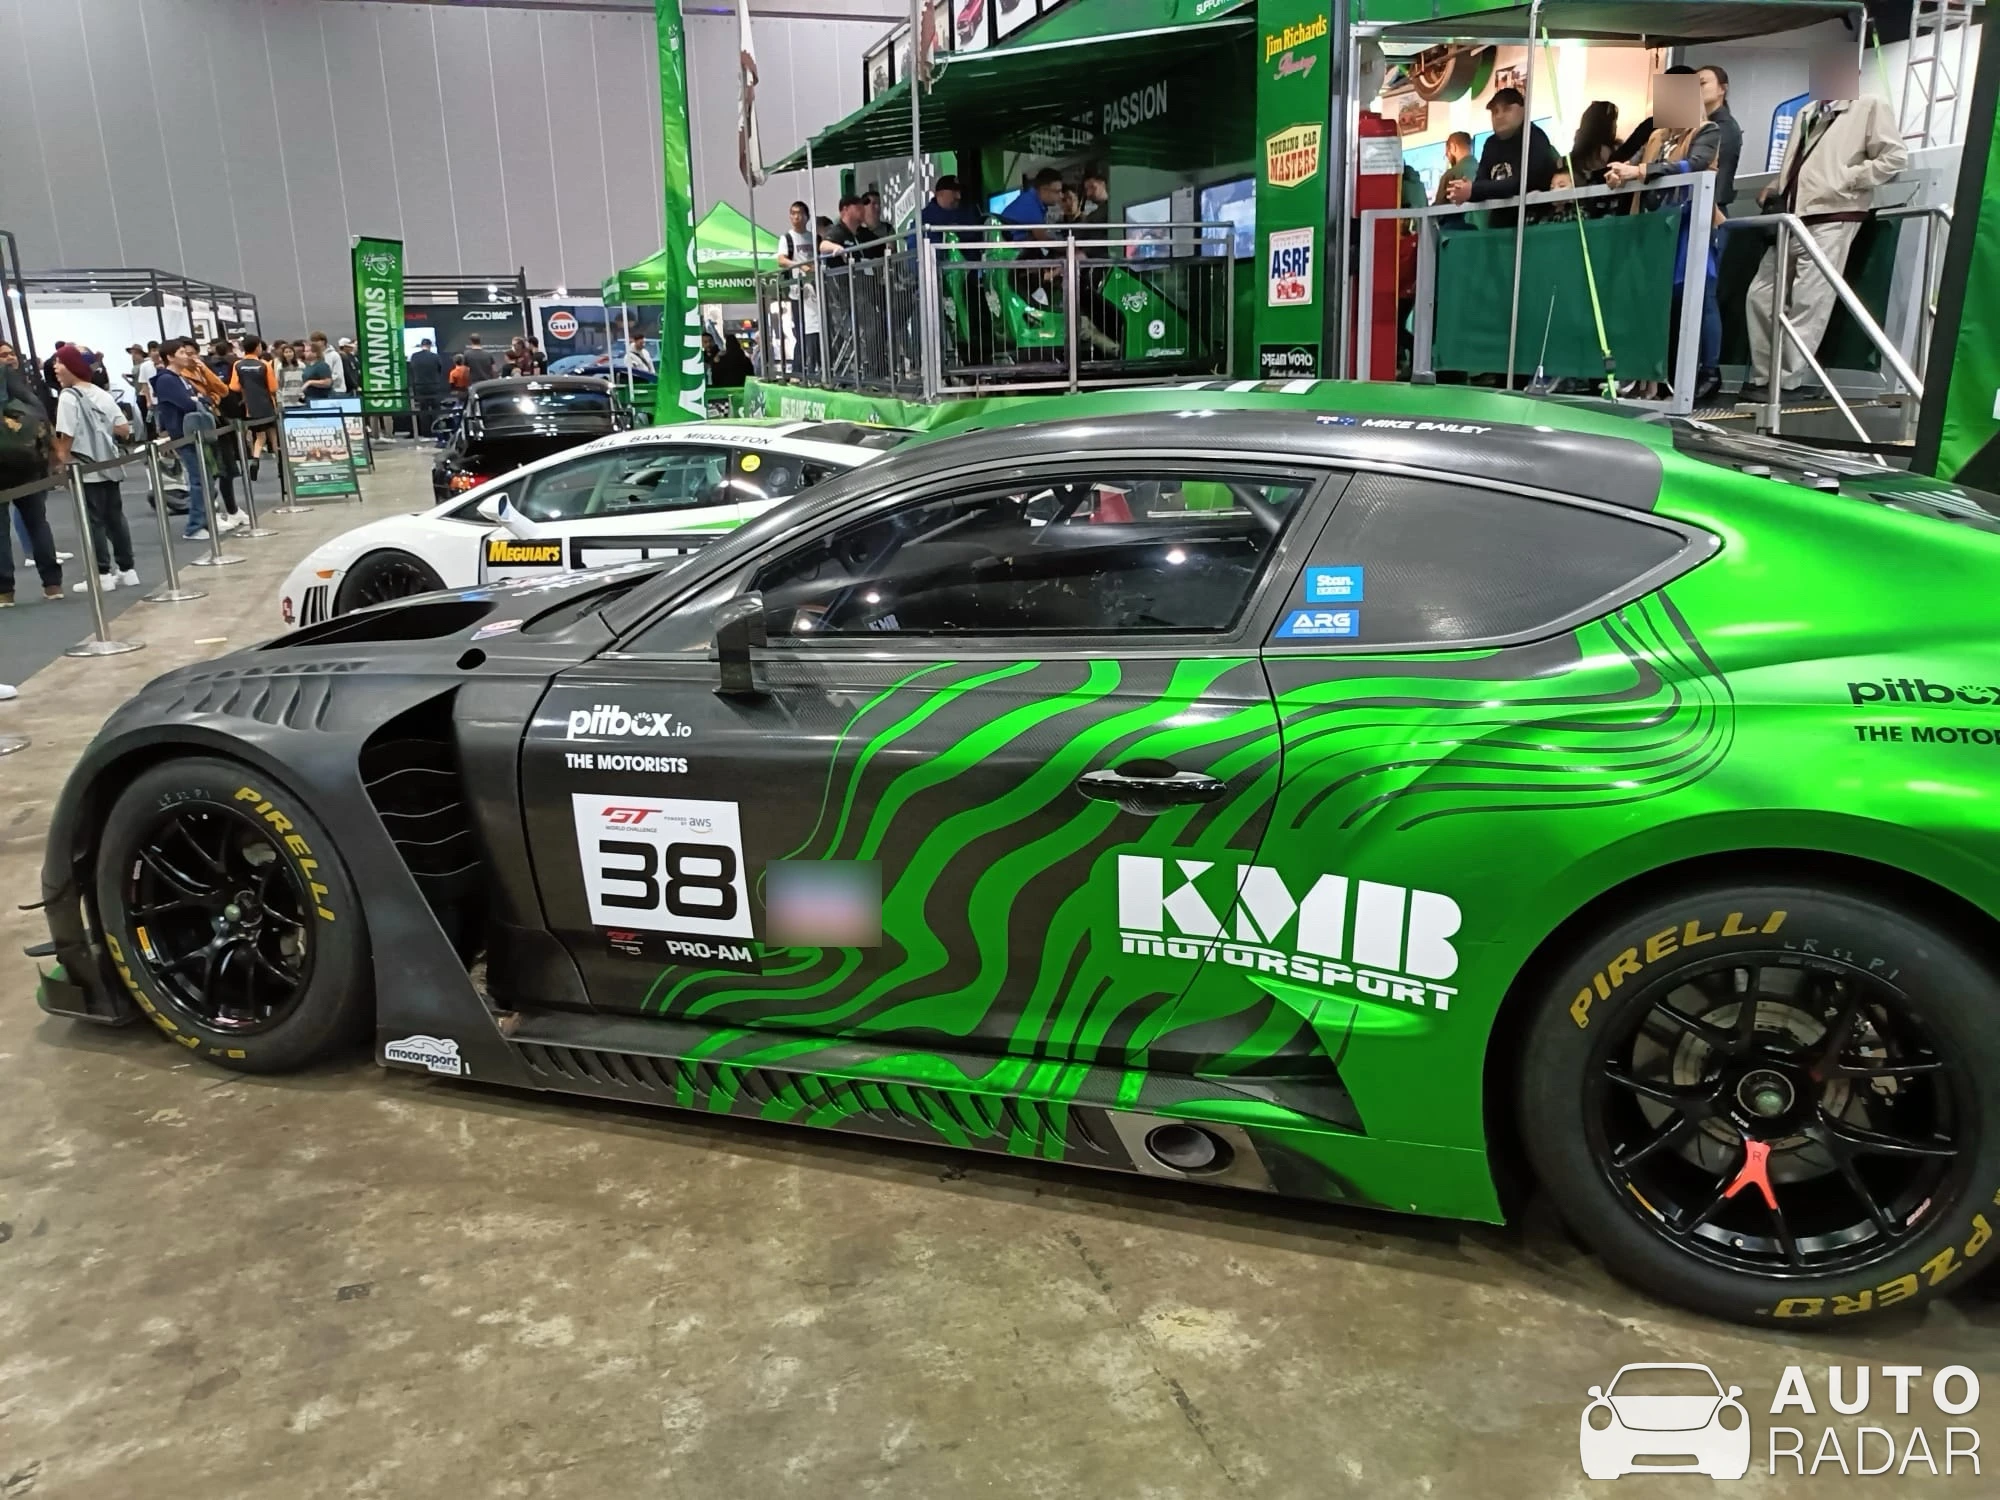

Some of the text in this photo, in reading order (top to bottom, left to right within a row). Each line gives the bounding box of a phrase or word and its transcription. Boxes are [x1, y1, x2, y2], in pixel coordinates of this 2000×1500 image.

[1265, 14, 1328, 64] Jim Richards
[1103, 79, 1168, 135] PASSION
[1270, 130, 1317, 156] TOURING CAR
[1270, 147, 1317, 182] MASTERS
[1271, 246, 1310, 280] ASRF
[550, 322, 576, 331] Gulf
[1153, 324, 1160, 335] 2
[364, 287, 393, 408] SHANNONS
[1261, 352, 1287, 367] DREAM
[1361, 418, 1492, 435] MIKE BAILEY
[584, 432, 773, 451] HILL BANA MIDDLETON
[1292, 612, 1351, 628] ARG
[1854, 725, 1903, 742] THE
[565, 752, 688, 774] THE MOTORISTS
[689, 817, 712, 828] aws
[234, 786, 336, 922] PIRELLI
[598, 839, 738, 921] 38
[1117, 853, 1463, 980] KMB
[665, 940, 753, 963] PRO-AM
[1119, 931, 1459, 1011] MOTORSPORT
[1569, 910, 1788, 1029] PIRELLI
[388, 1048, 458, 1068] motorsport
[1752, 1150, 1762, 1161] R
